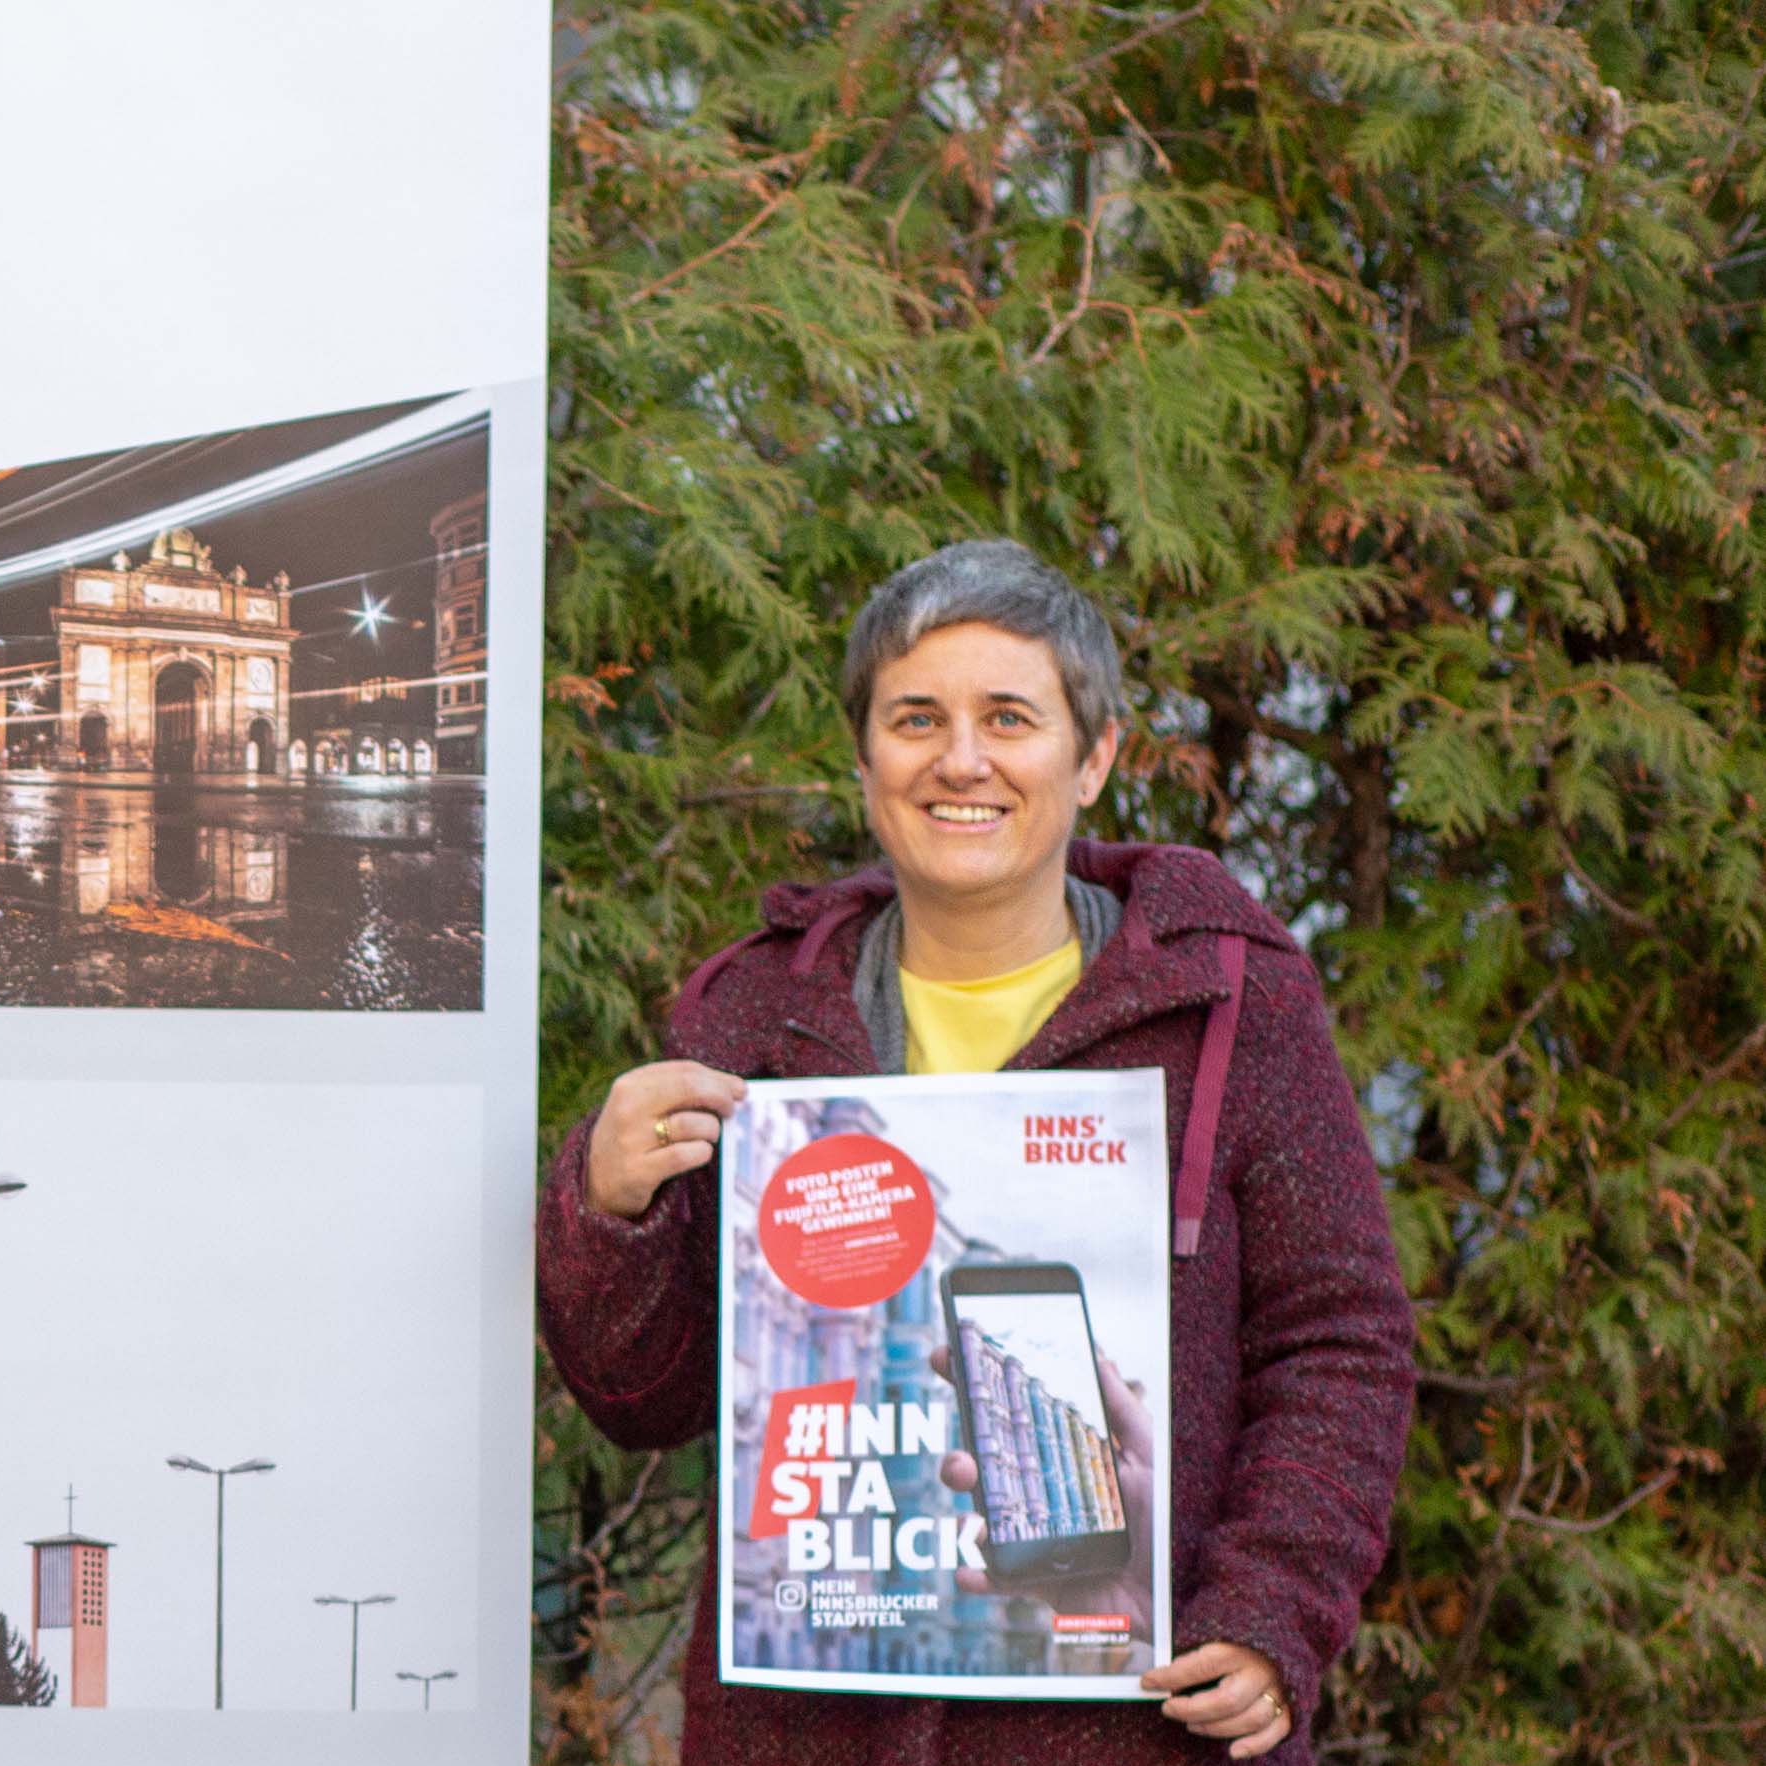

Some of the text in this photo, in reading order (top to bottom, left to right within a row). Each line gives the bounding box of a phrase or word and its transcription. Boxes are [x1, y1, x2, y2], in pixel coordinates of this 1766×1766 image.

[1024, 1141, 1126, 1164] BRUCK
[785, 1160, 894, 1194] FOTO POSTEN
[784, 1402, 947, 1456] #INN
[770, 1460, 896, 1515] STA
[787, 1516, 988, 1572] BLICK
[811, 1580, 856, 1594] MEIN
[811, 1594, 939, 1610] INNSBRUCKER
[811, 1611, 906, 1627] STADTTEIL
